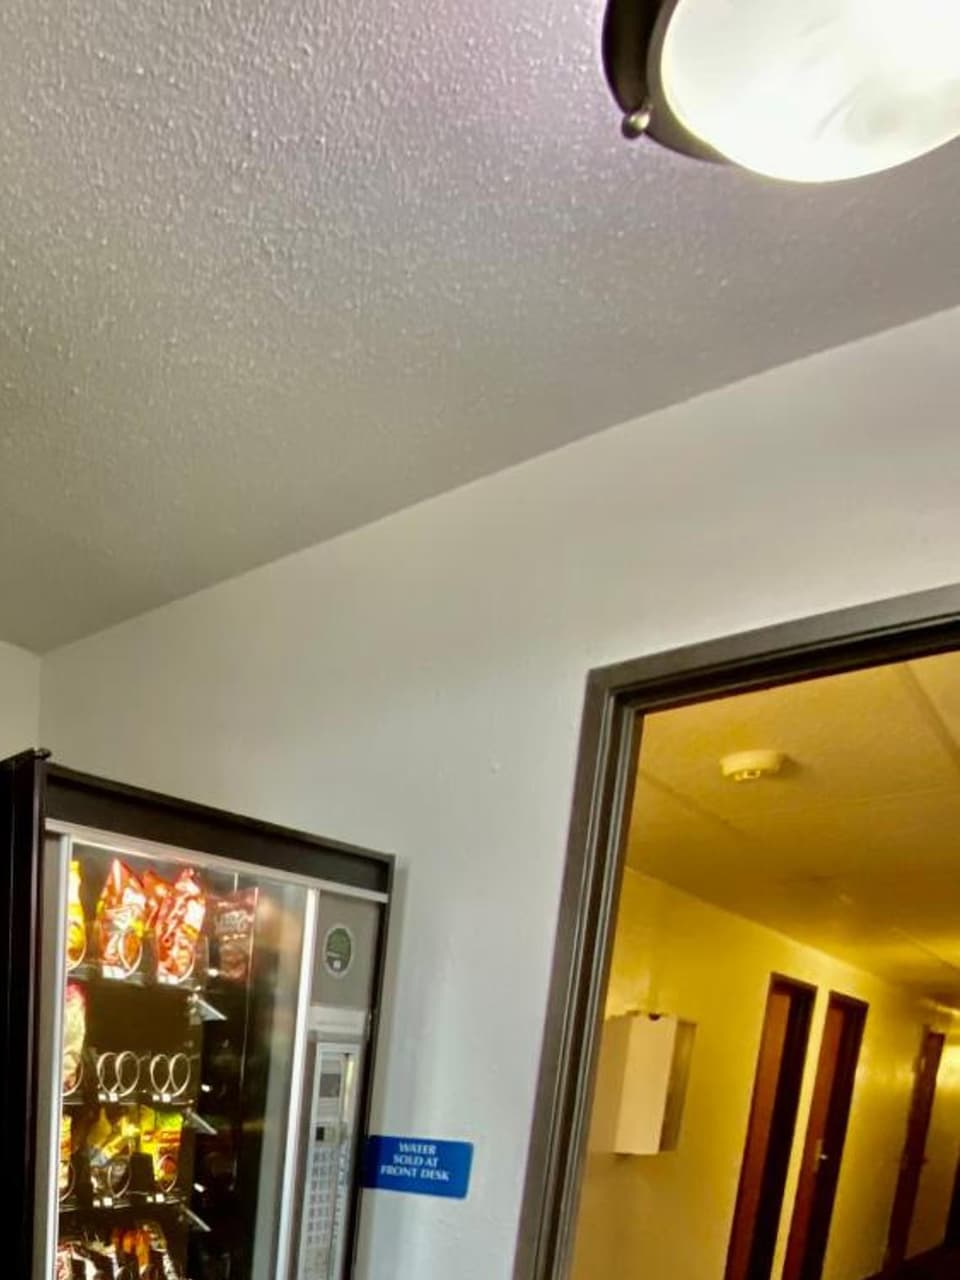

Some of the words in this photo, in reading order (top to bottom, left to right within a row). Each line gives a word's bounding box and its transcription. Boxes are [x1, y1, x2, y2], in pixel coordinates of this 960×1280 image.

[399, 1142, 437, 1155] WATER
[392, 1154, 424, 1166] SOLD
[424, 1157, 439, 1168] AT
[380, 1165, 417, 1178] FRONT
[420, 1169, 451, 1182] DESK
